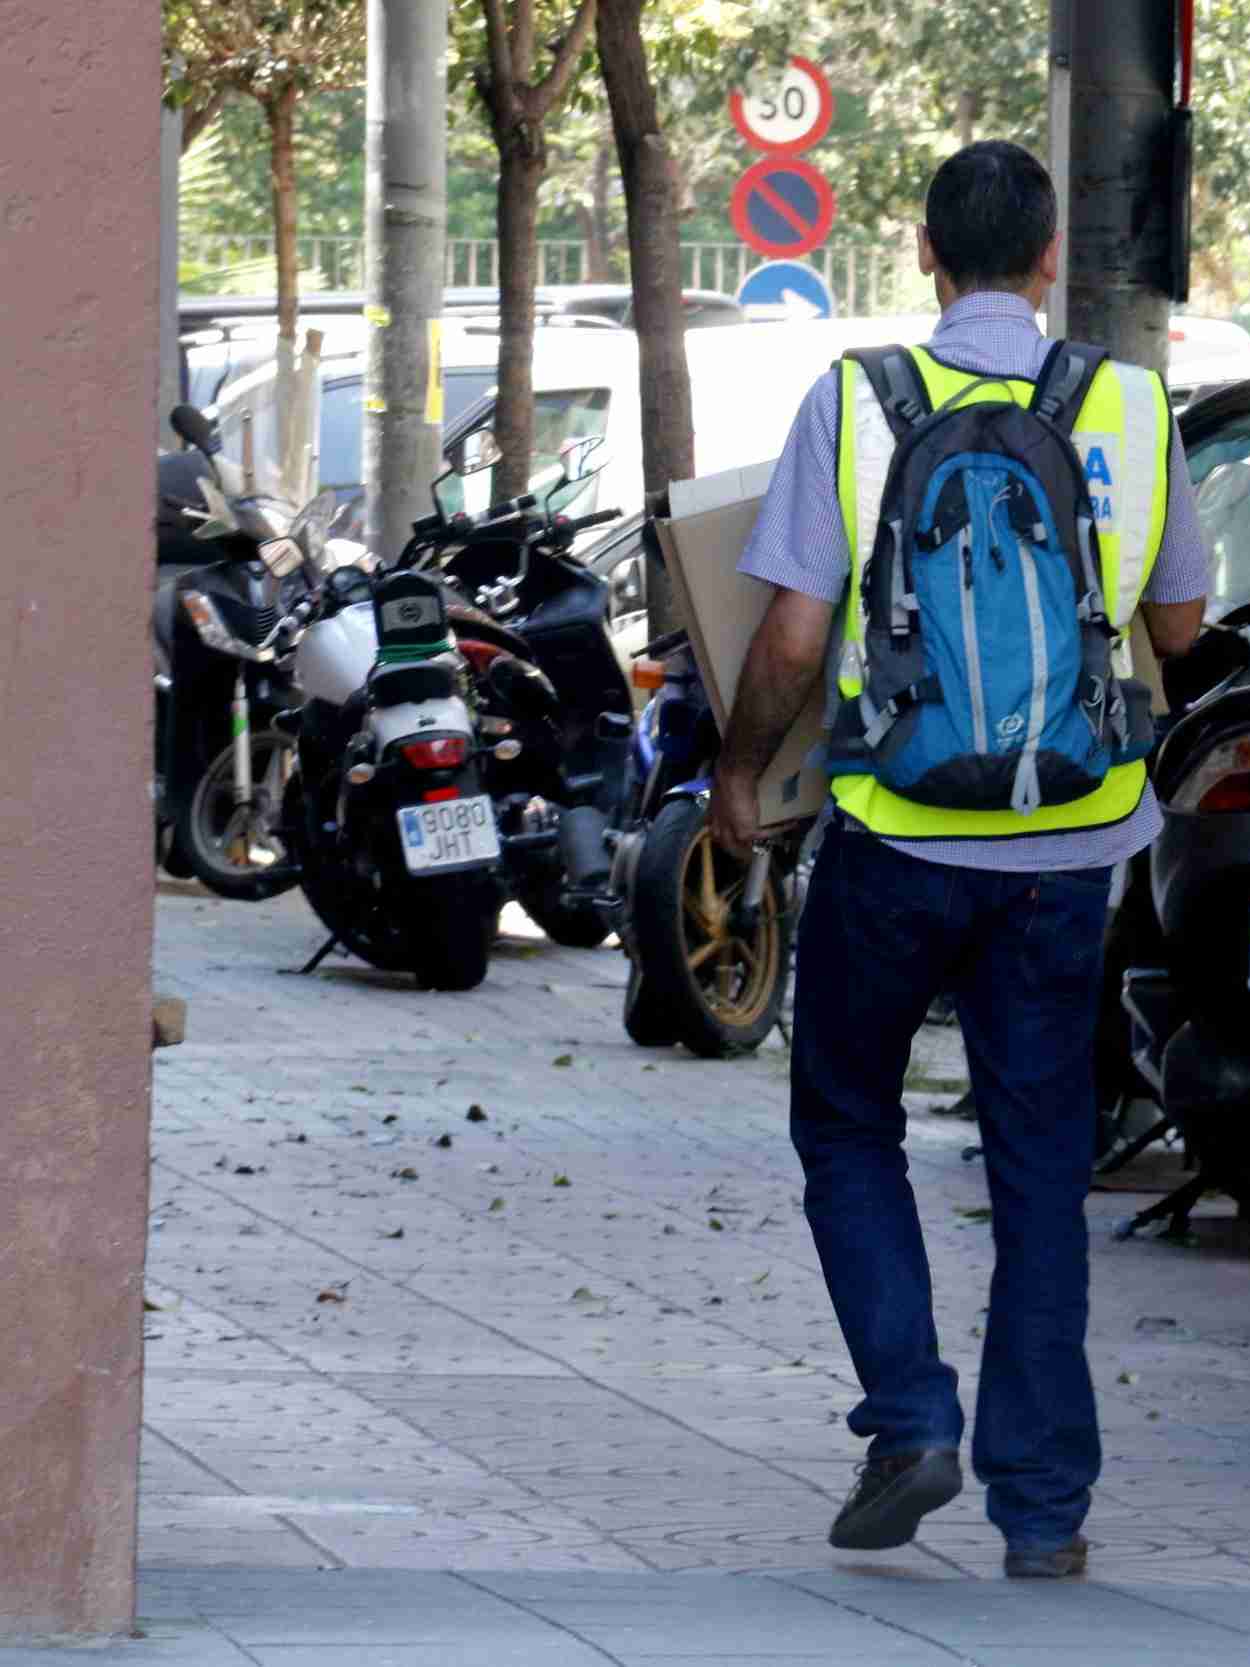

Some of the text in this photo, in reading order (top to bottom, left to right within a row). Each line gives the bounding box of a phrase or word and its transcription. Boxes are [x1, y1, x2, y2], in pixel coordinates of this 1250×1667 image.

[759, 86, 805, 119] 50
[422, 801, 487, 834] 9080
[430, 830, 472, 860] JHT
